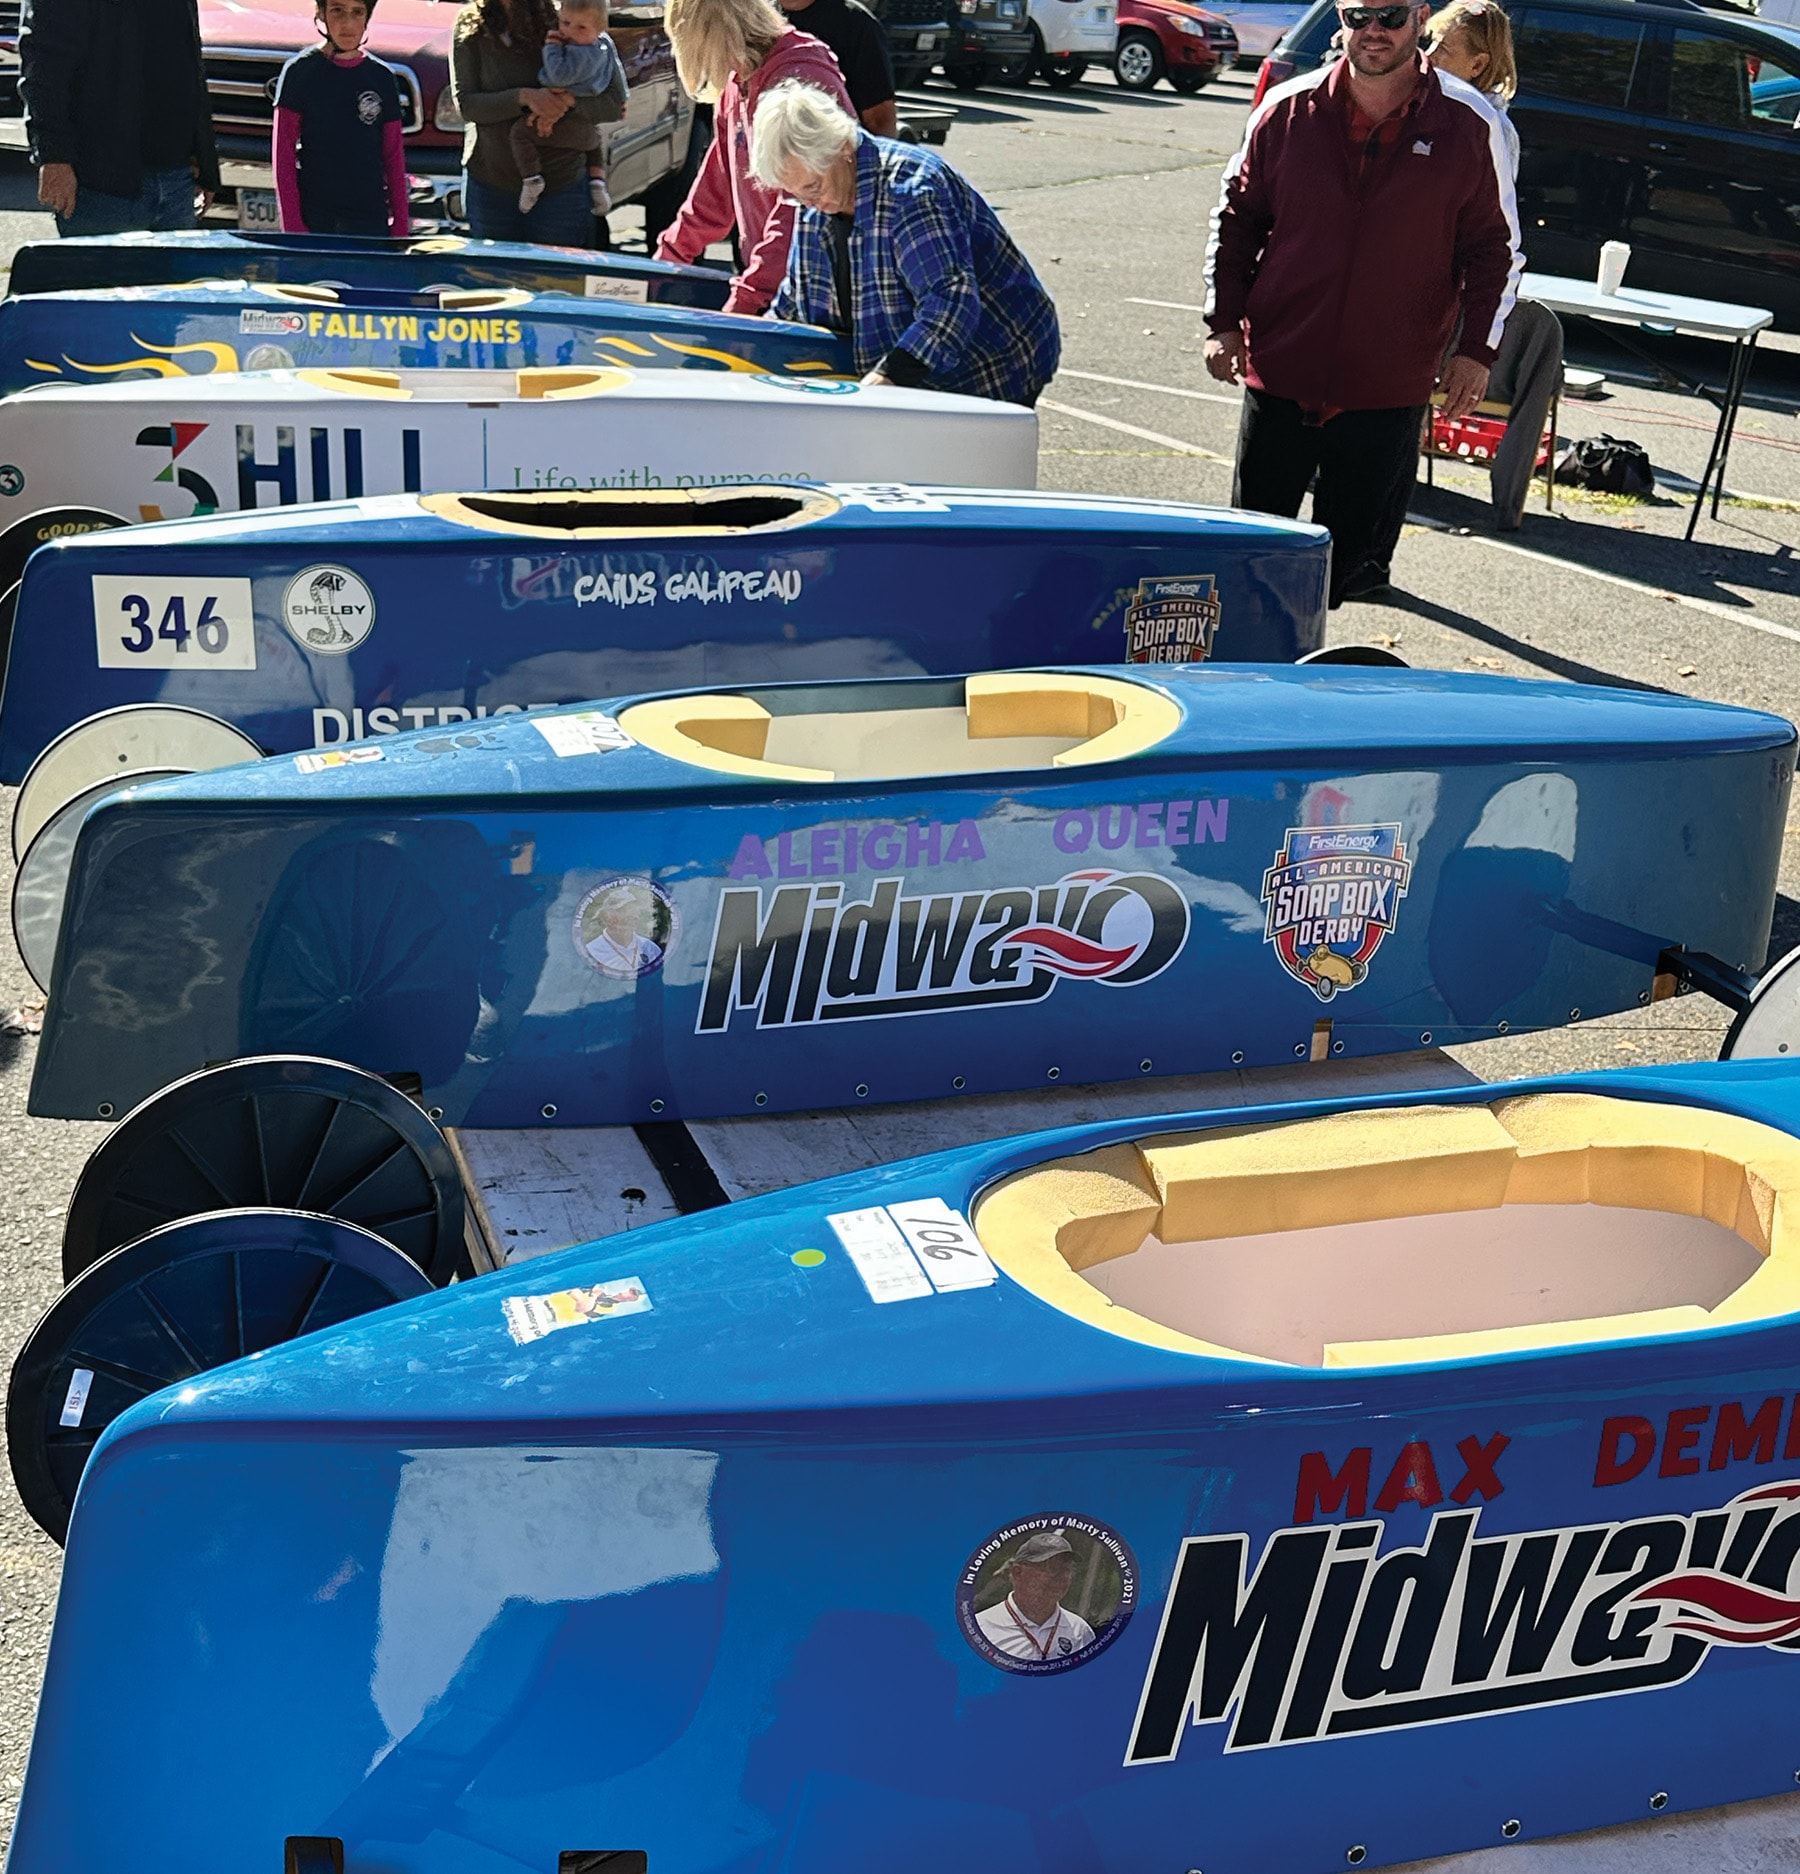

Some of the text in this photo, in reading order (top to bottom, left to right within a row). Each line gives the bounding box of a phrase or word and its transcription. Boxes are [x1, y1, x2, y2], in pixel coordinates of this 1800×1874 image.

[309, 312, 521, 344] FALLYN JONES
[590, 466, 662, 488] with
[121, 595, 229, 653] 346
[291, 602, 366, 618] SHELBY
[1131, 603, 1216, 622] ALL-AMERICAN
[1133, 617, 1209, 651] SOAP BOX
[1149, 645, 1191, 663] DERBY
[729, 799, 1230, 881] ALEIGHA QUEEN
[1272, 861, 1404, 888] ALL-AMERICAN
[1275, 879, 1391, 928] SOAP BOX
[1299, 917, 1364, 945] DERBY
[904, 1218, 978, 1260] 106
[1294, 1431, 1510, 1524] MAX
[963, 1516, 1134, 1604] In Loving Memory of Marty Sullivan 2021
